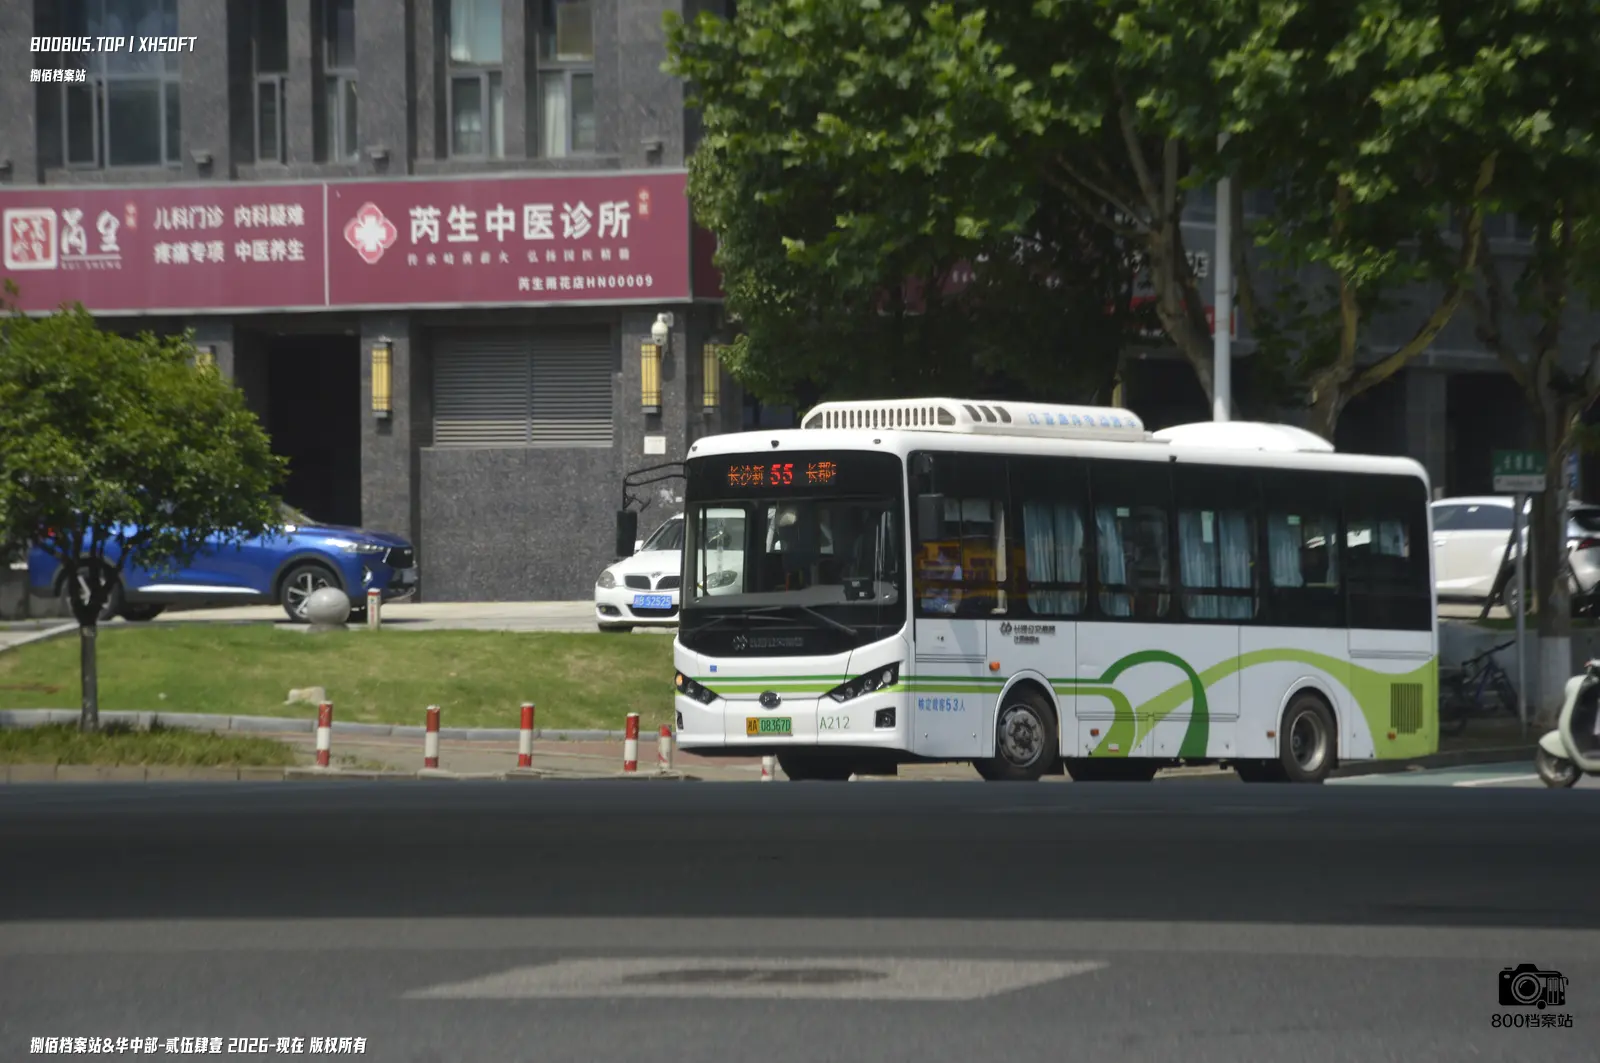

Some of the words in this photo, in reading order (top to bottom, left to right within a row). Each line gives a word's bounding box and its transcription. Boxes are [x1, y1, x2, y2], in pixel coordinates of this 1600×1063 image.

[153, 205, 224, 231] 儿科门诊
[234, 203, 305, 228] 内科疑难
[410, 201, 631, 244] 芮生中医诊所
[234, 238, 305, 263] 中医养生
[769, 463, 794, 485] 55
[820, 716, 850, 730] A212
